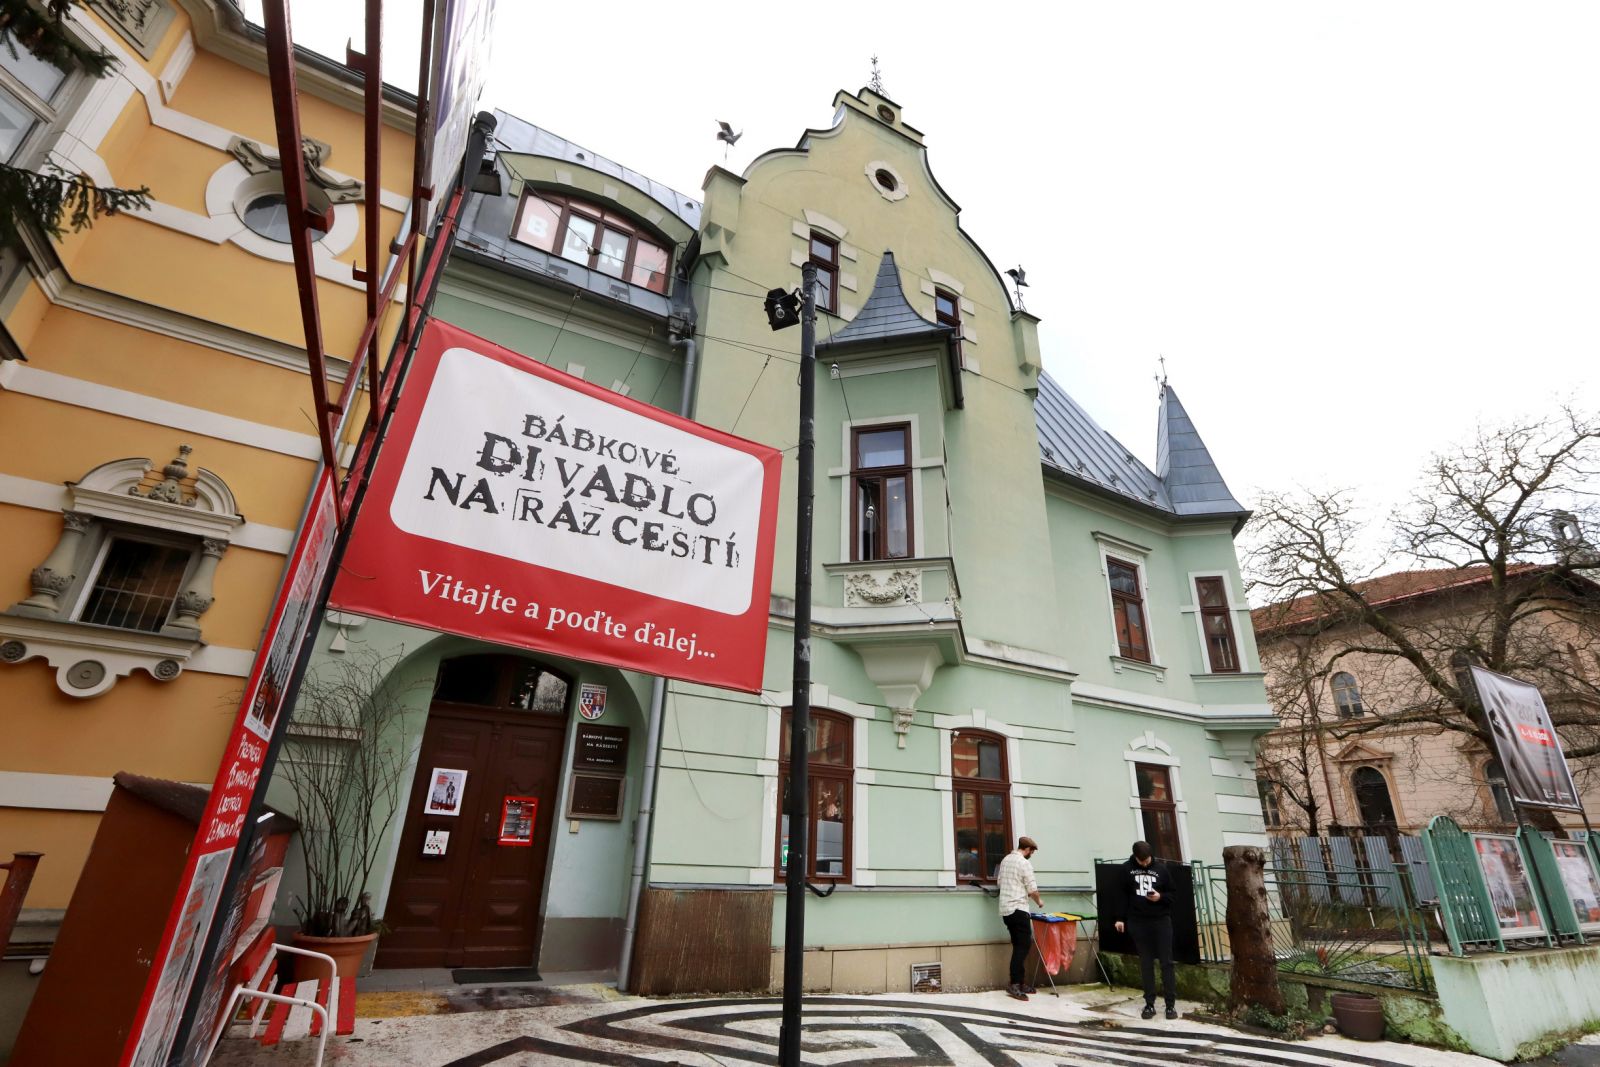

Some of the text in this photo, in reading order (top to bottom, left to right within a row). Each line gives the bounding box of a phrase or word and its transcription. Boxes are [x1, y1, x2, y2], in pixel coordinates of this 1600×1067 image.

[476, 431, 717, 527] DIVADLO
[521, 413, 680, 475] BÁBKOVÉ
[423, 466, 738, 568] NA RÁZCESTÍ
[417, 569, 716, 661] Vitajte a poďte ďalej...
